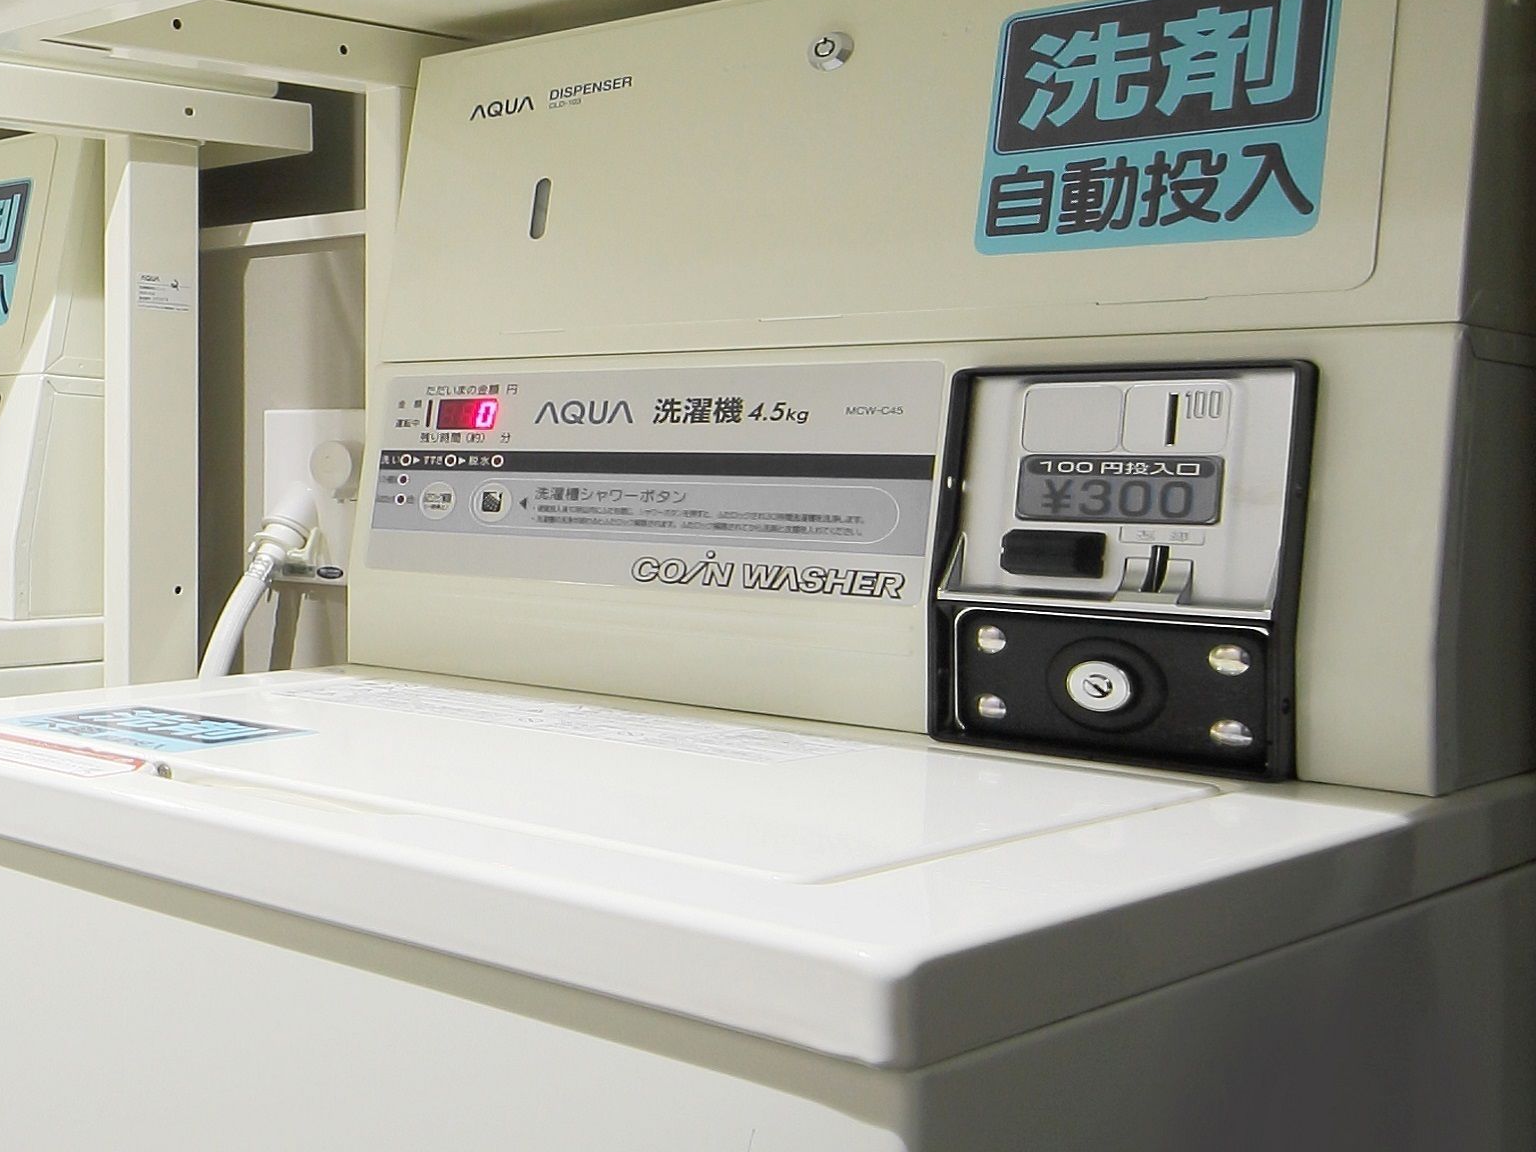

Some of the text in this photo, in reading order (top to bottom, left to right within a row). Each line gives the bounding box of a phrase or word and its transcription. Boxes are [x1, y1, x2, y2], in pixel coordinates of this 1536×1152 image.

[469, 76, 633, 121] AQUA DISPENSER
[985, 142, 1315, 237] 自動投入
[506, 384, 518, 395] 円
[474, 401, 498, 428] 0
[534, 400, 633, 425] AQUA
[652, 397, 744, 425] 洗濯機
[748, 401, 809, 424] 4.5kg
[1185, 390, 1222, 419] 100
[499, 432, 511, 444] 分
[1039, 460, 1201, 477] 100円投入口
[535, 487, 687, 504] 洗濯槽シャワーボタン
[1041, 478, 1193, 519] ¥300
[632, 550, 905, 599] COIN WASHER
